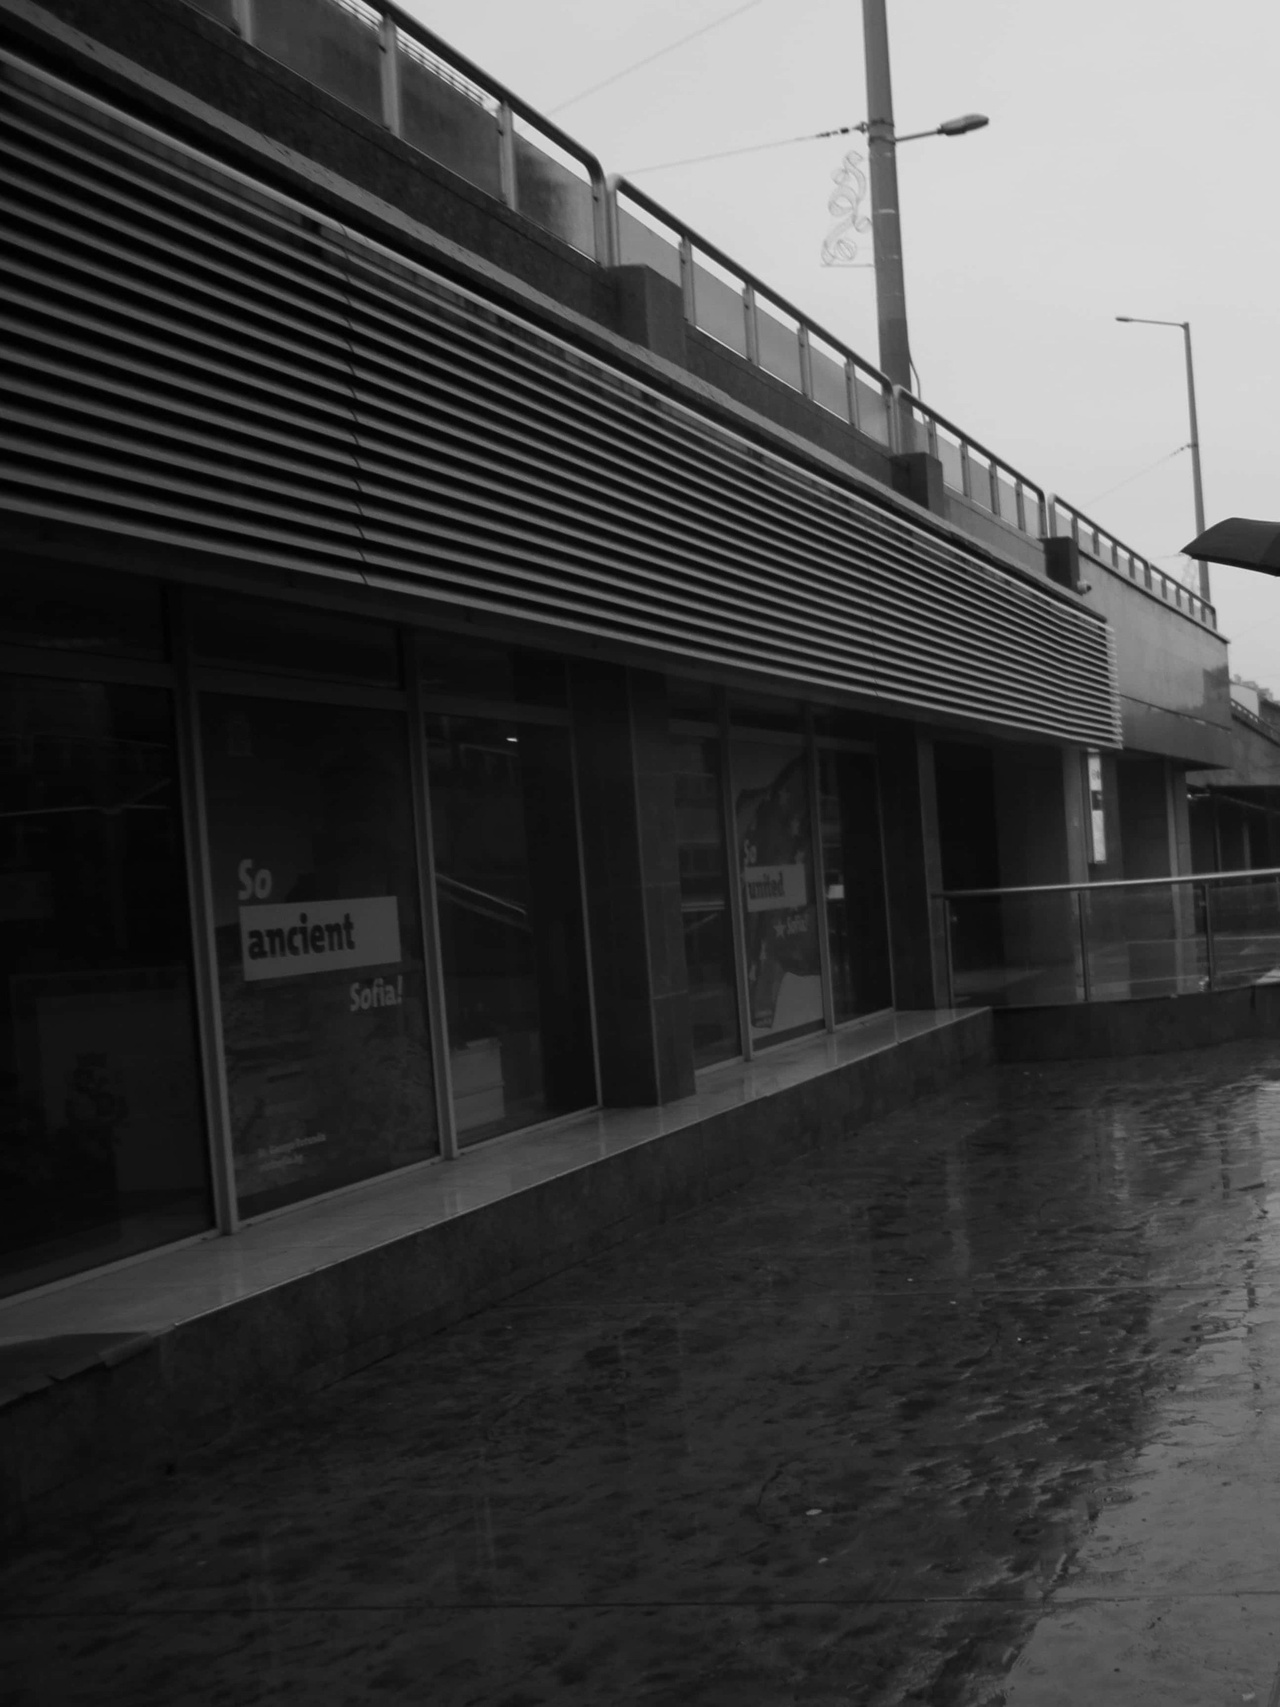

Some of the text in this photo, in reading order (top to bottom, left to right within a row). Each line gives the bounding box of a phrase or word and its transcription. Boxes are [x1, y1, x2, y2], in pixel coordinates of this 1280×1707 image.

[238, 859, 272, 900] So
[748, 870, 784, 899] united
[248, 912, 355, 960] ancient
[350, 975, 404, 1012] Sofia!
